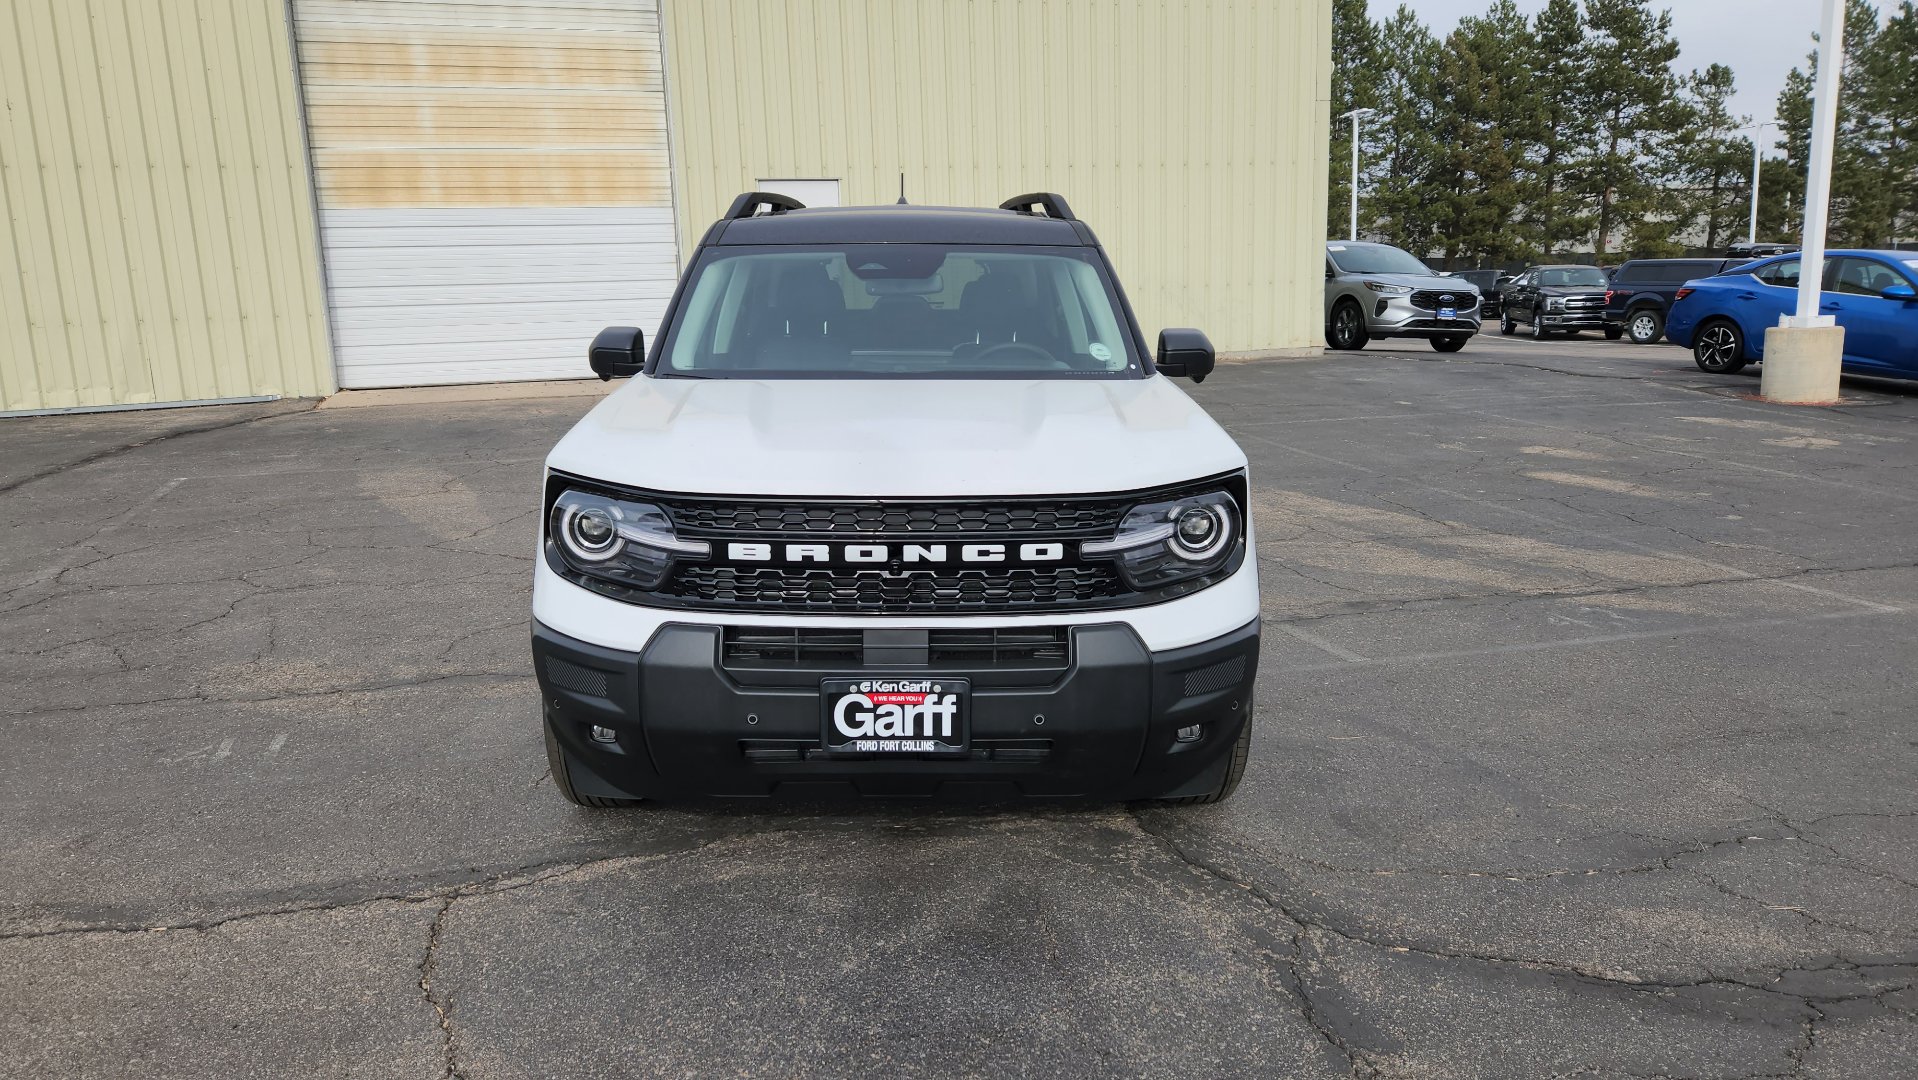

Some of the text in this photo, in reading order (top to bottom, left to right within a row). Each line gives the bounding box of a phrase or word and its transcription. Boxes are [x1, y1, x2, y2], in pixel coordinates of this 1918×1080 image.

[728, 542, 1064, 561] BRONCO
[873, 681, 931, 692] Ken Garff
[834, 693, 957, 737] Garff
[857, 741, 934, 751] FORD FORT COLLINS
